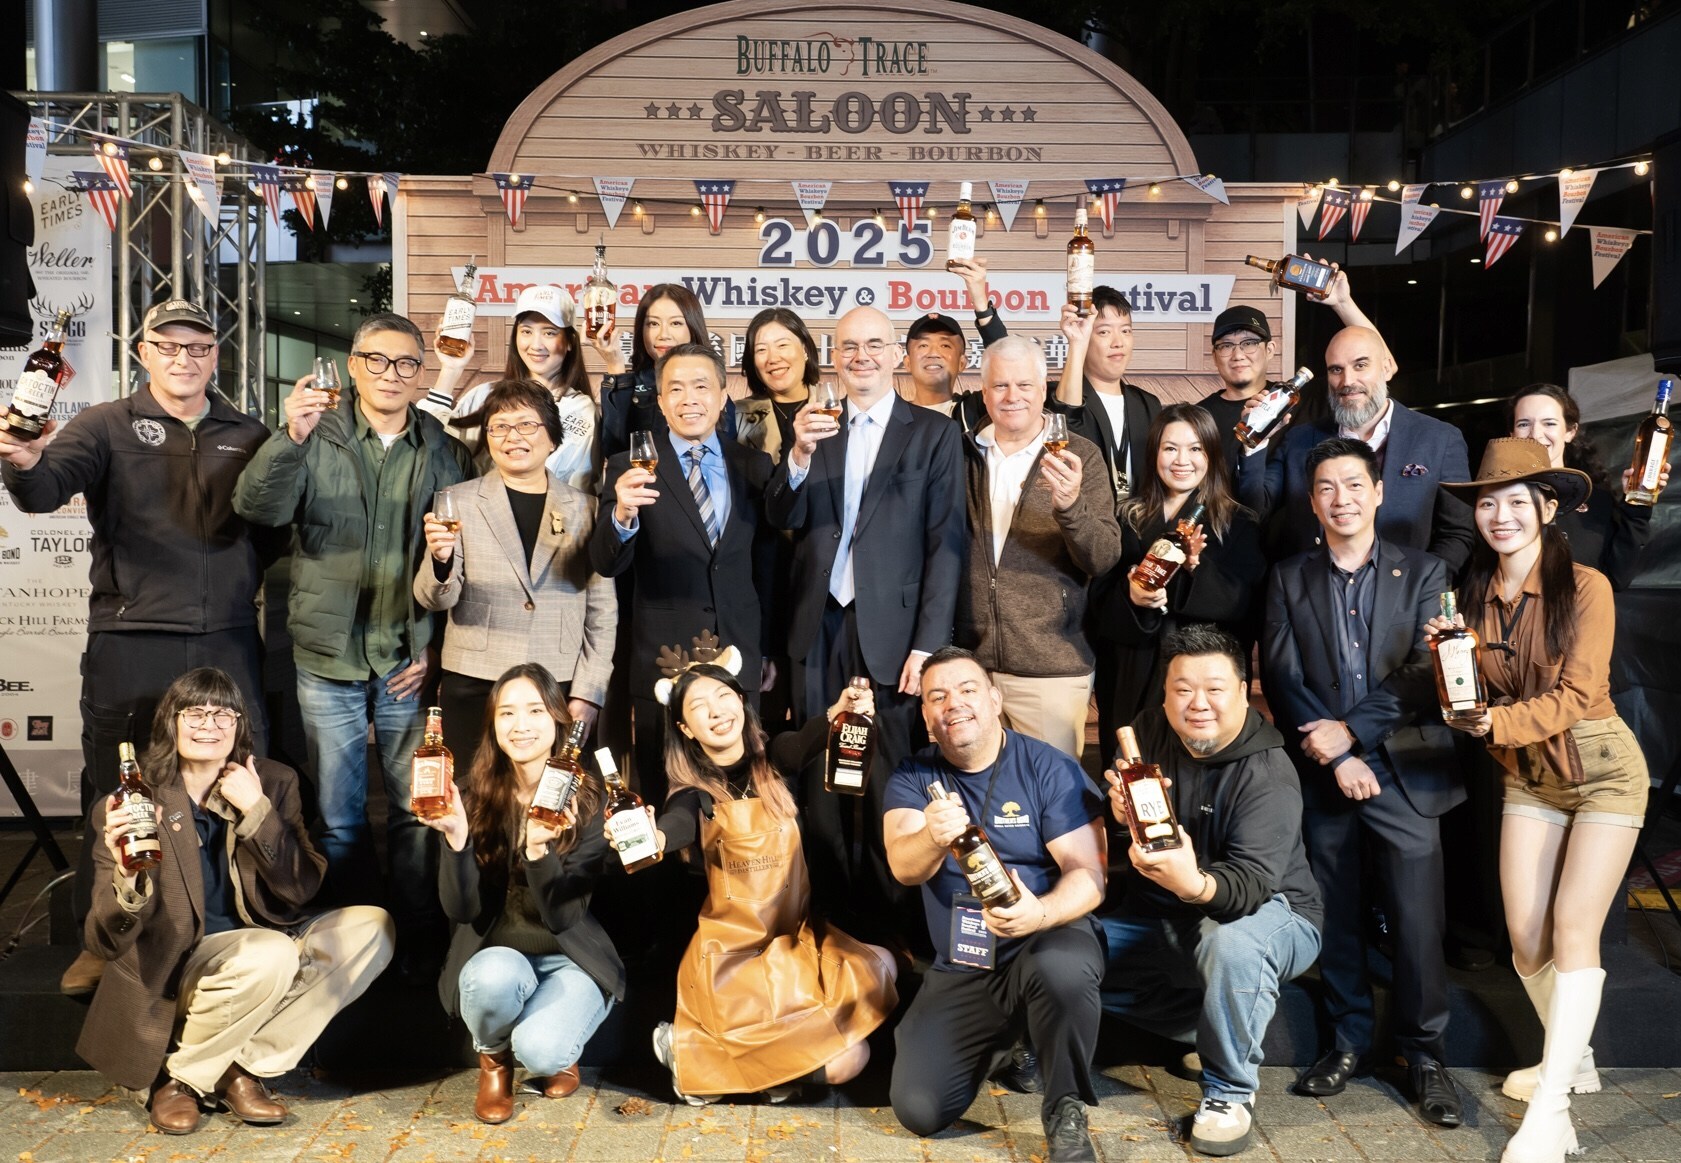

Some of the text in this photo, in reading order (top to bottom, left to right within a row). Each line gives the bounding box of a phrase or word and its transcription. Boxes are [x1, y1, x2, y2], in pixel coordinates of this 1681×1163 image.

[736, 35, 831, 75] BUFFALO
[858, 36, 929, 77] TRACE
[711, 89, 972, 134] SALOON
[636, 143, 780, 160] WHISKEY
[804, 145, 883, 160] BEER
[907, 146, 1043, 162] BOURBON
[40, 191, 81, 215] EARLY
[41, 204, 83, 230] TIMES
[761, 221, 931, 267] 2025
[1596, 232, 1630, 240] American
[1594, 251, 1621, 259] Festival
[1595, 244, 1624, 253] Bourbon
[681, 276, 848, 315] Whiskey
[856, 286, 874, 305] &
[40, 320, 86, 337] SGG
[561, 421, 588, 437] TIMES
[564, 414, 591, 430] EARLY
[0, 587, 91, 598] ANHOPE
[19, 615, 48, 626] HILL
[841, 722, 869, 736] ELIJAH
[840, 732, 867, 745] CRAIG
[1140, 800, 1165, 817] RYE
[728, 858, 761, 869] HEAVEN
[957, 943, 989, 957] STAFF
